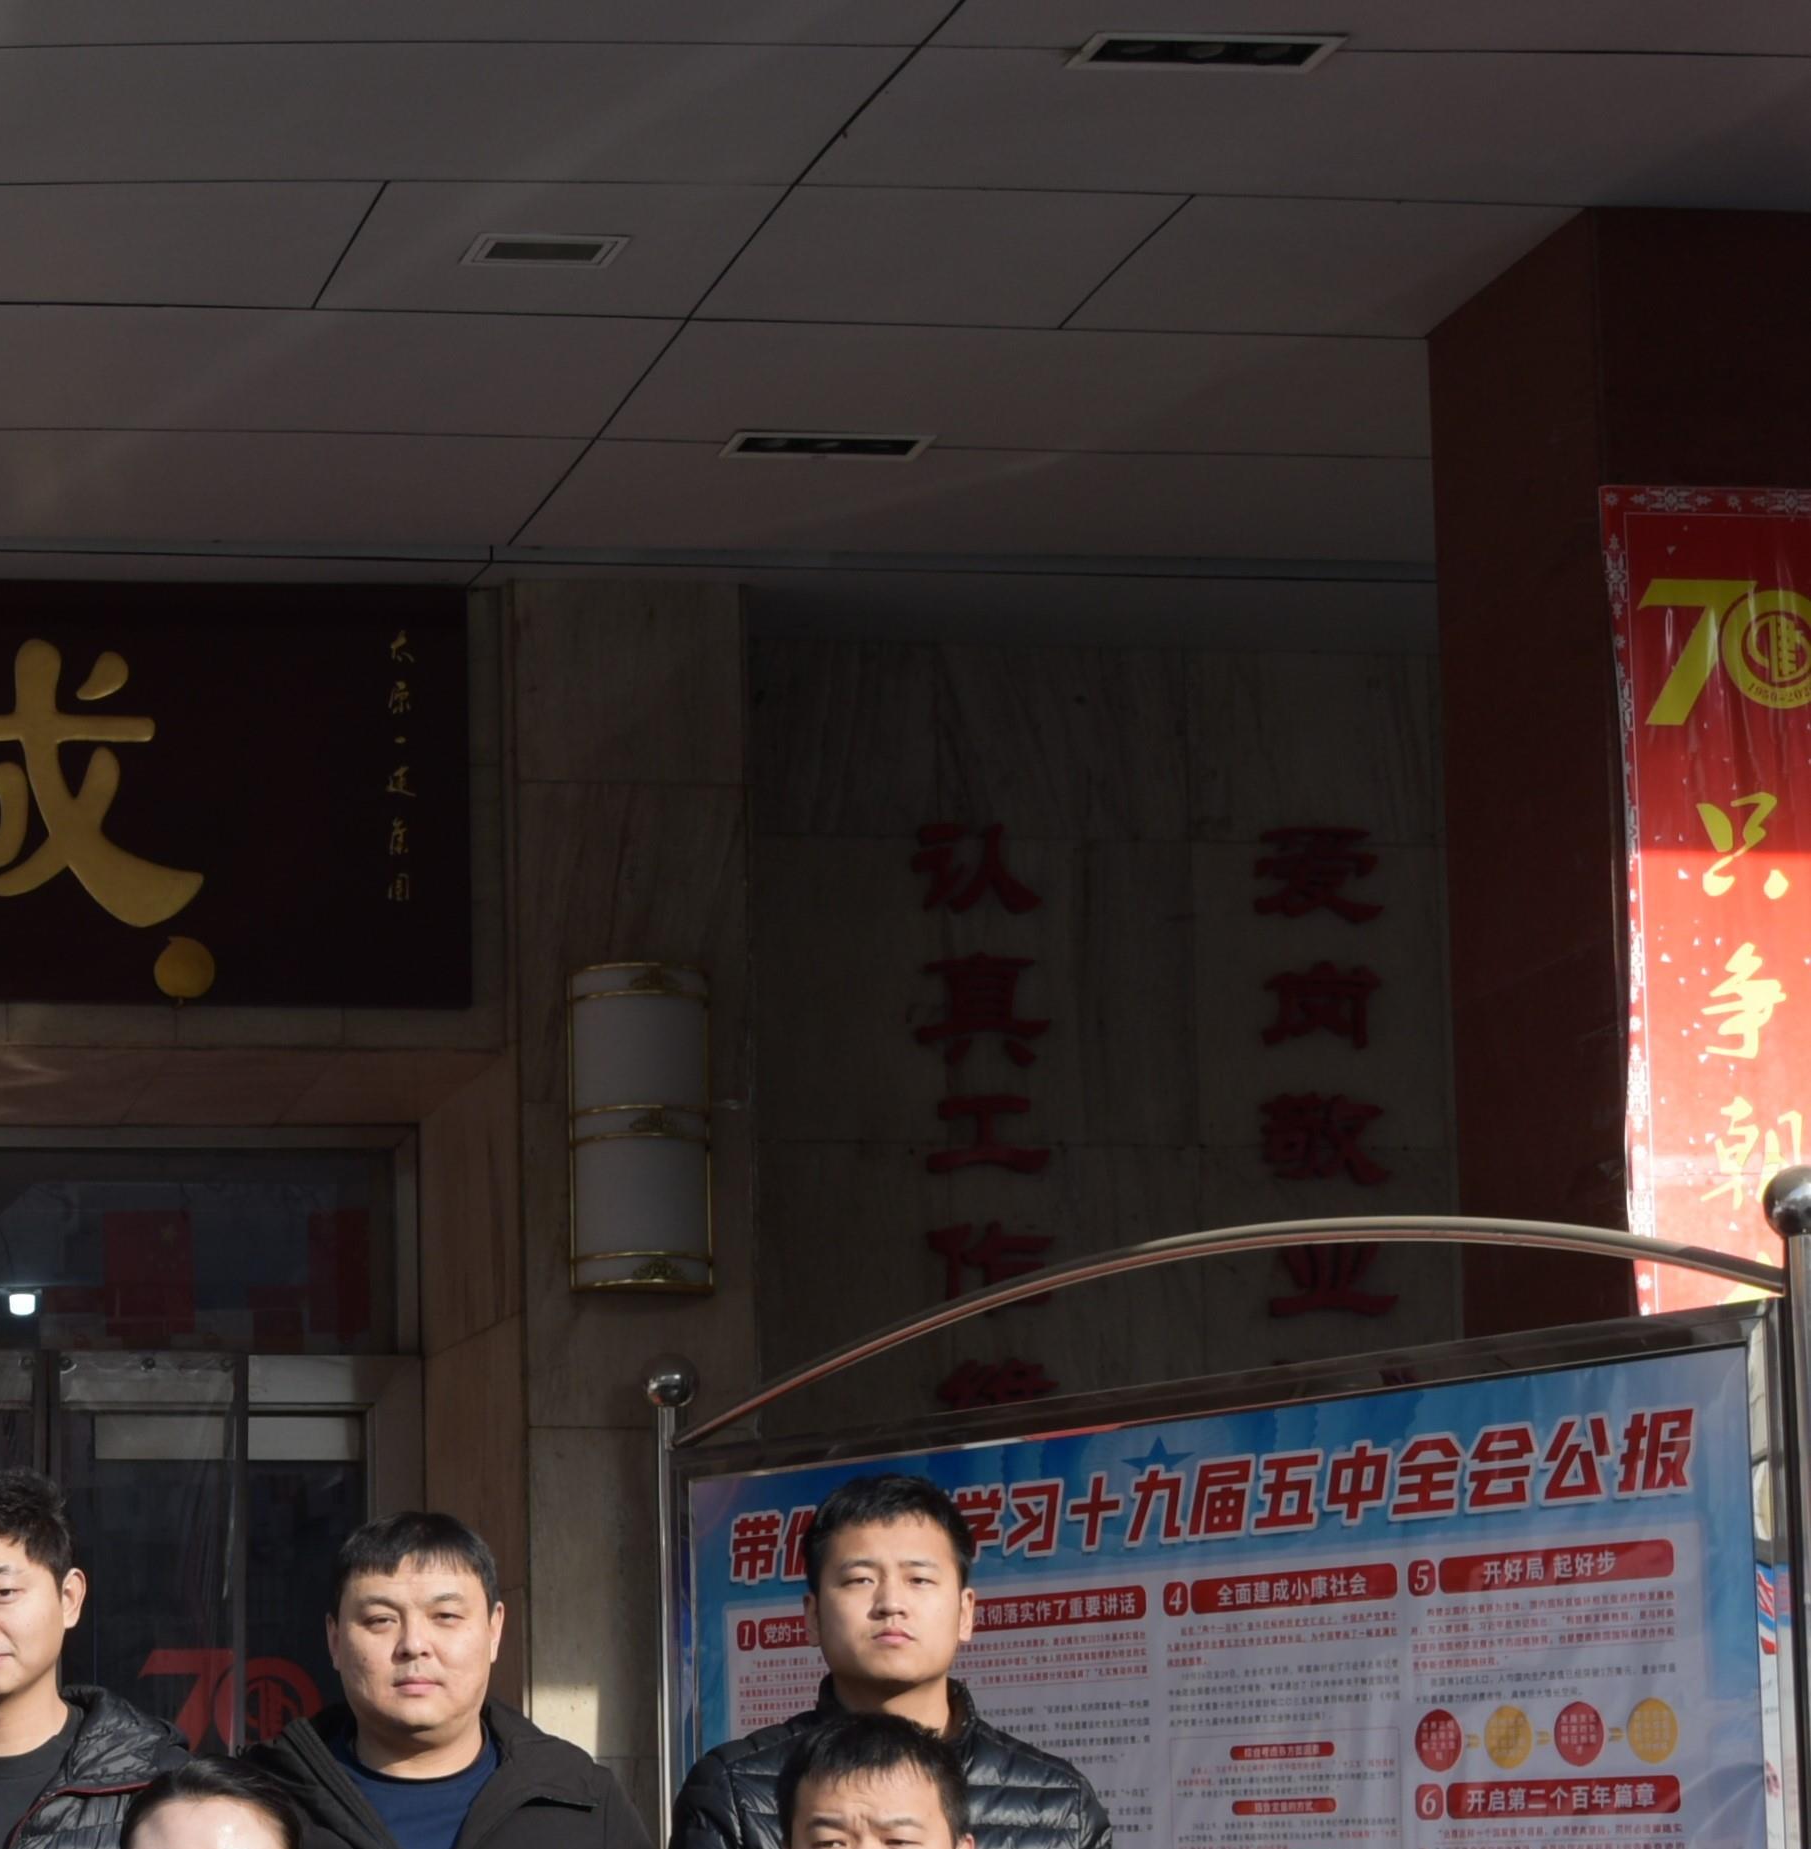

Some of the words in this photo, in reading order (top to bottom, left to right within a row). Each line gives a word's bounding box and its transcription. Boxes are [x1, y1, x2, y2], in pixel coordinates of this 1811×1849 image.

[1413, 1564, 1430, 1591] 5
[1482, 1556, 1545, 1586] 开好局
[1552, 1549, 1618, 1579] 起好步
[1168, 1587, 1183, 1612] 4
[1216, 1571, 1368, 1608] 全面建成小康社会
[740, 1624, 752, 1647] 1
[1421, 1788, 1437, 1815] 6
[1467, 1782, 1657, 1813] 开启第二个百年篇章
